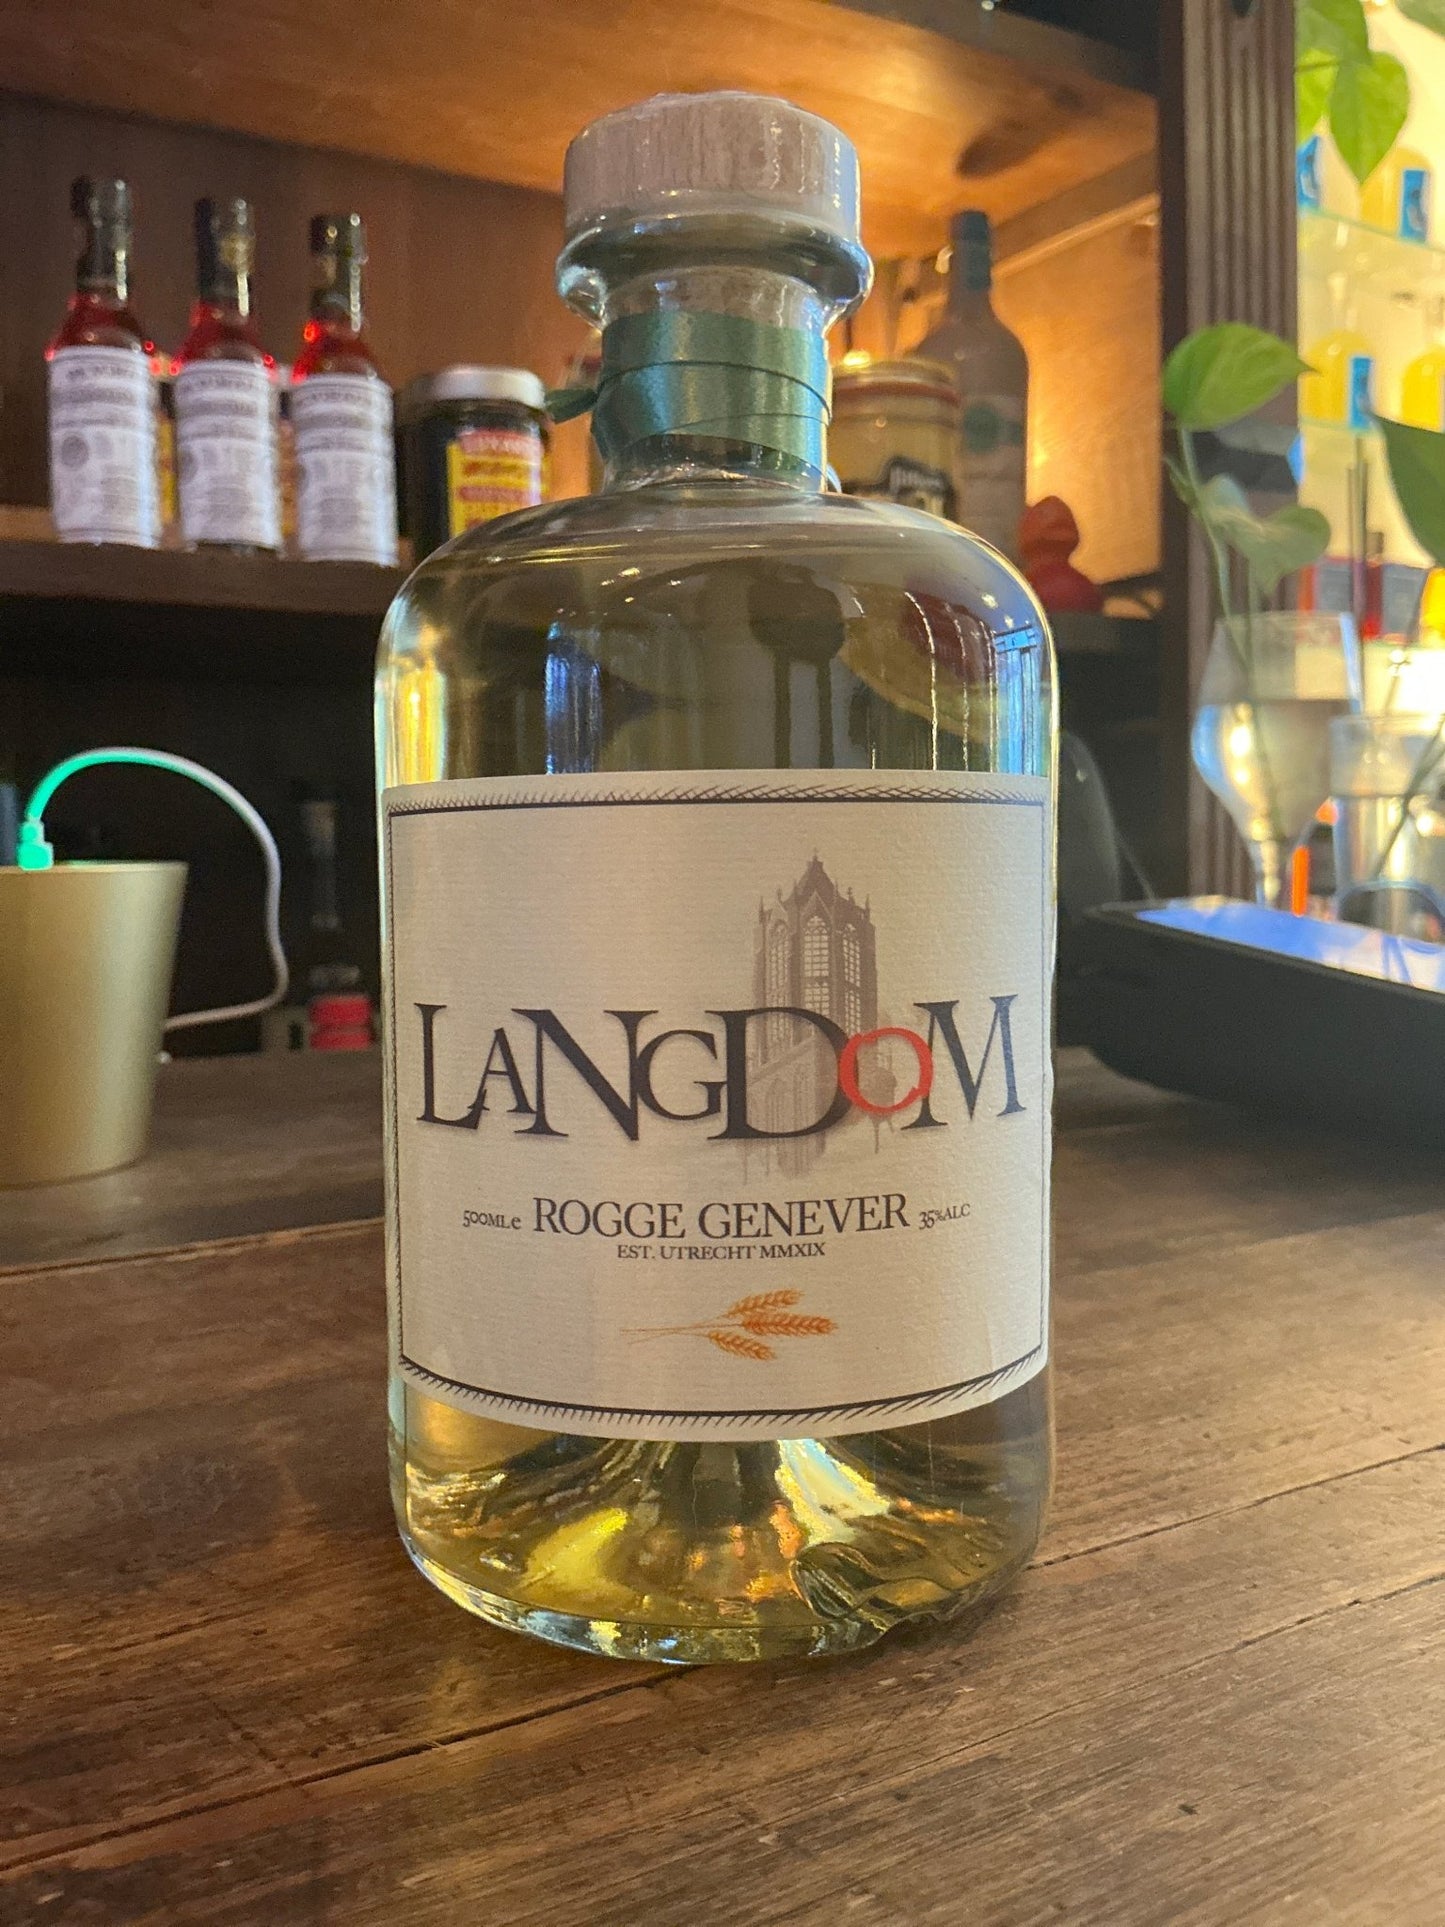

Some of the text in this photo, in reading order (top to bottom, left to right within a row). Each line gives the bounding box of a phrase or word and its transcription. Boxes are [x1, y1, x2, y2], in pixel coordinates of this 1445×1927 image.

[413, 994, 1028, 1142] LANGDOM
[532, 1197, 687, 1239] ROGGE
[697, 1193, 911, 1240] GENEVER
[616, 1242, 826, 1261] EST. UTRECHT MMXIX
